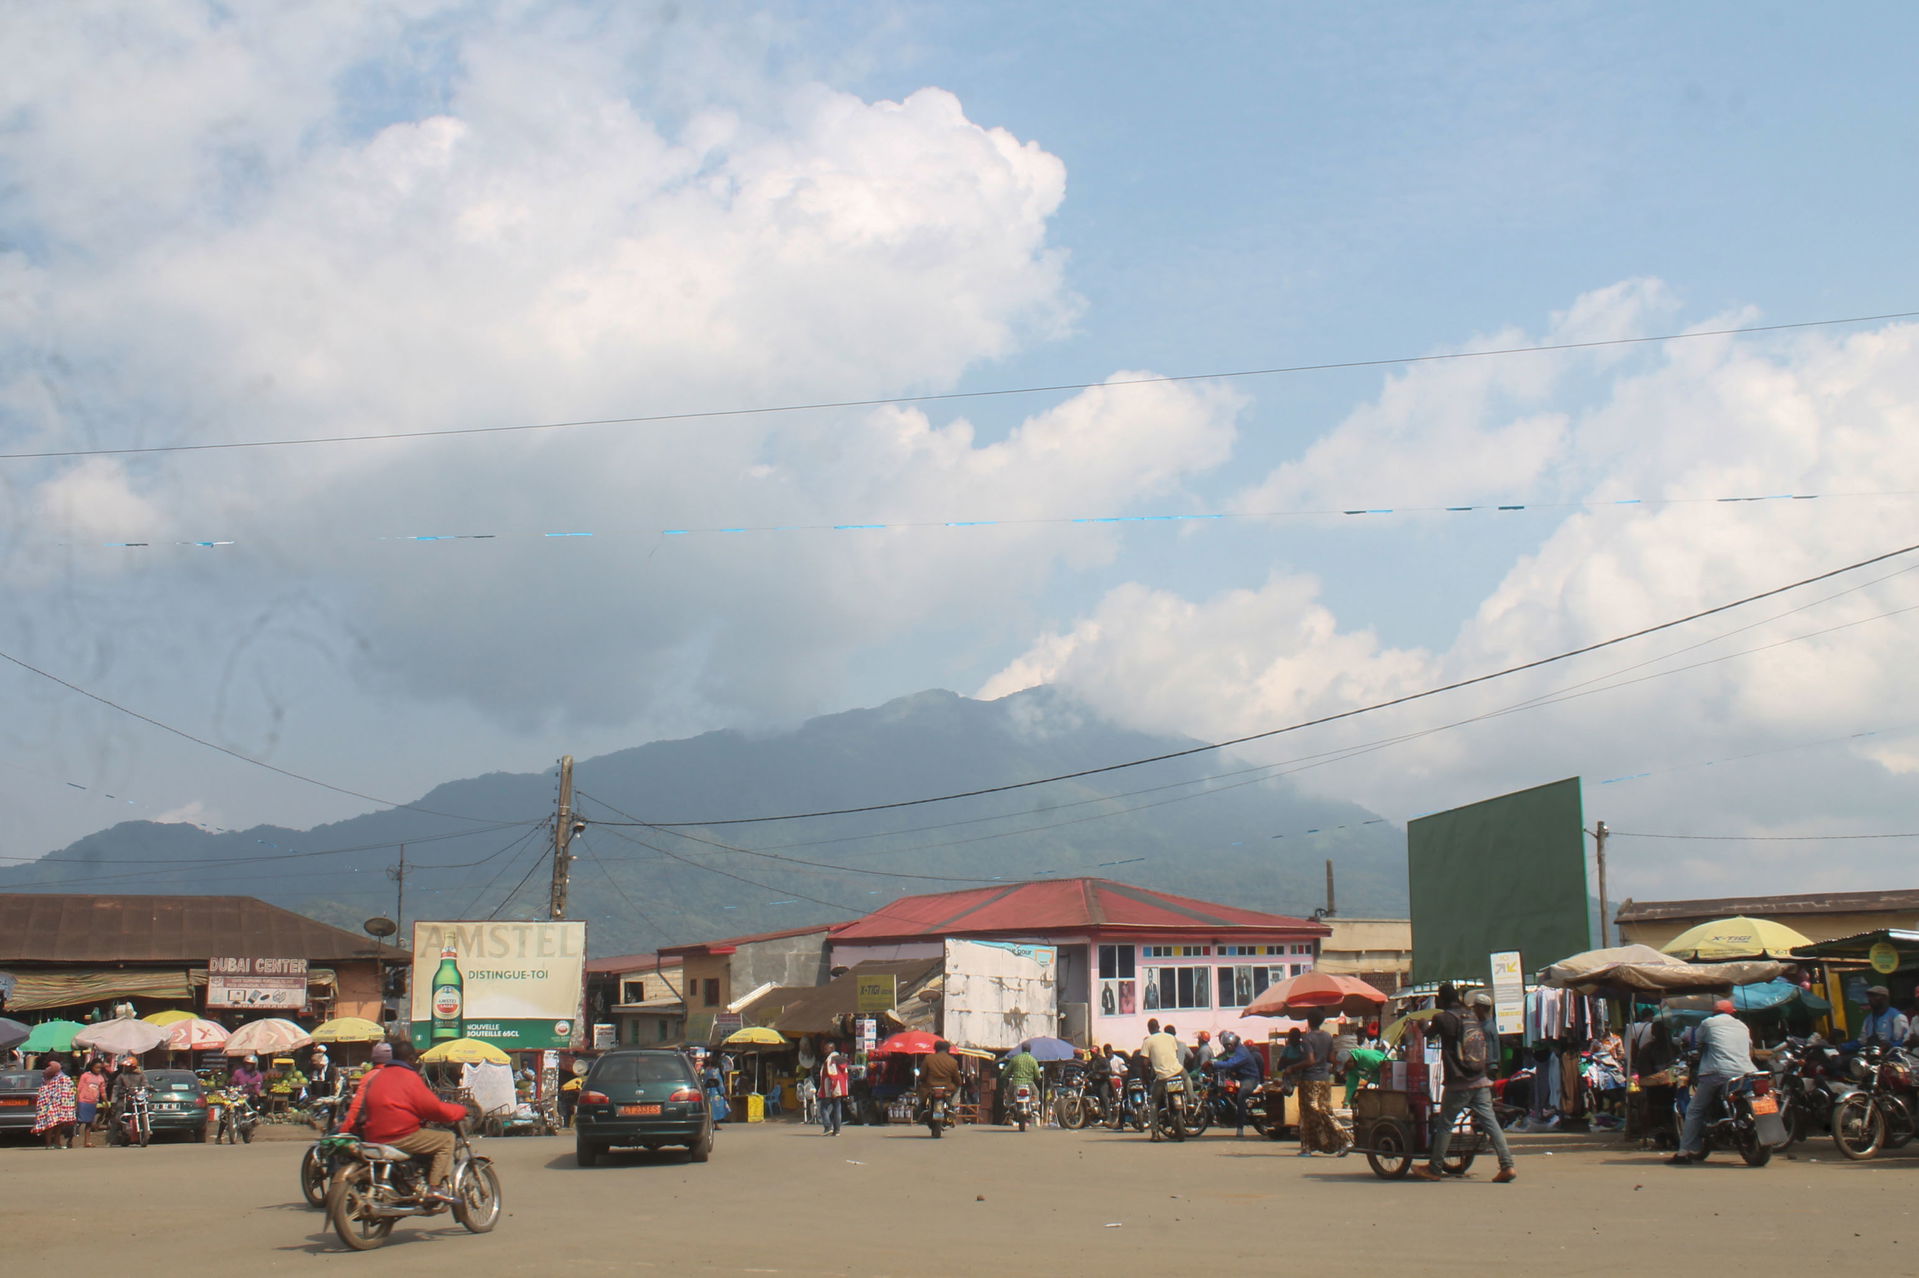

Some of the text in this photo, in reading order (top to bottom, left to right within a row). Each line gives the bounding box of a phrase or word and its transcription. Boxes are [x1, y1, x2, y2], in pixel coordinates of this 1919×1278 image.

[417, 924, 578, 958] AMSTEL
[209, 957, 308, 974] DUBAI CENTER
[468, 970, 549, 980] DISTINGUE-TOI
[467, 1023, 500, 1031] NOUVELLE
